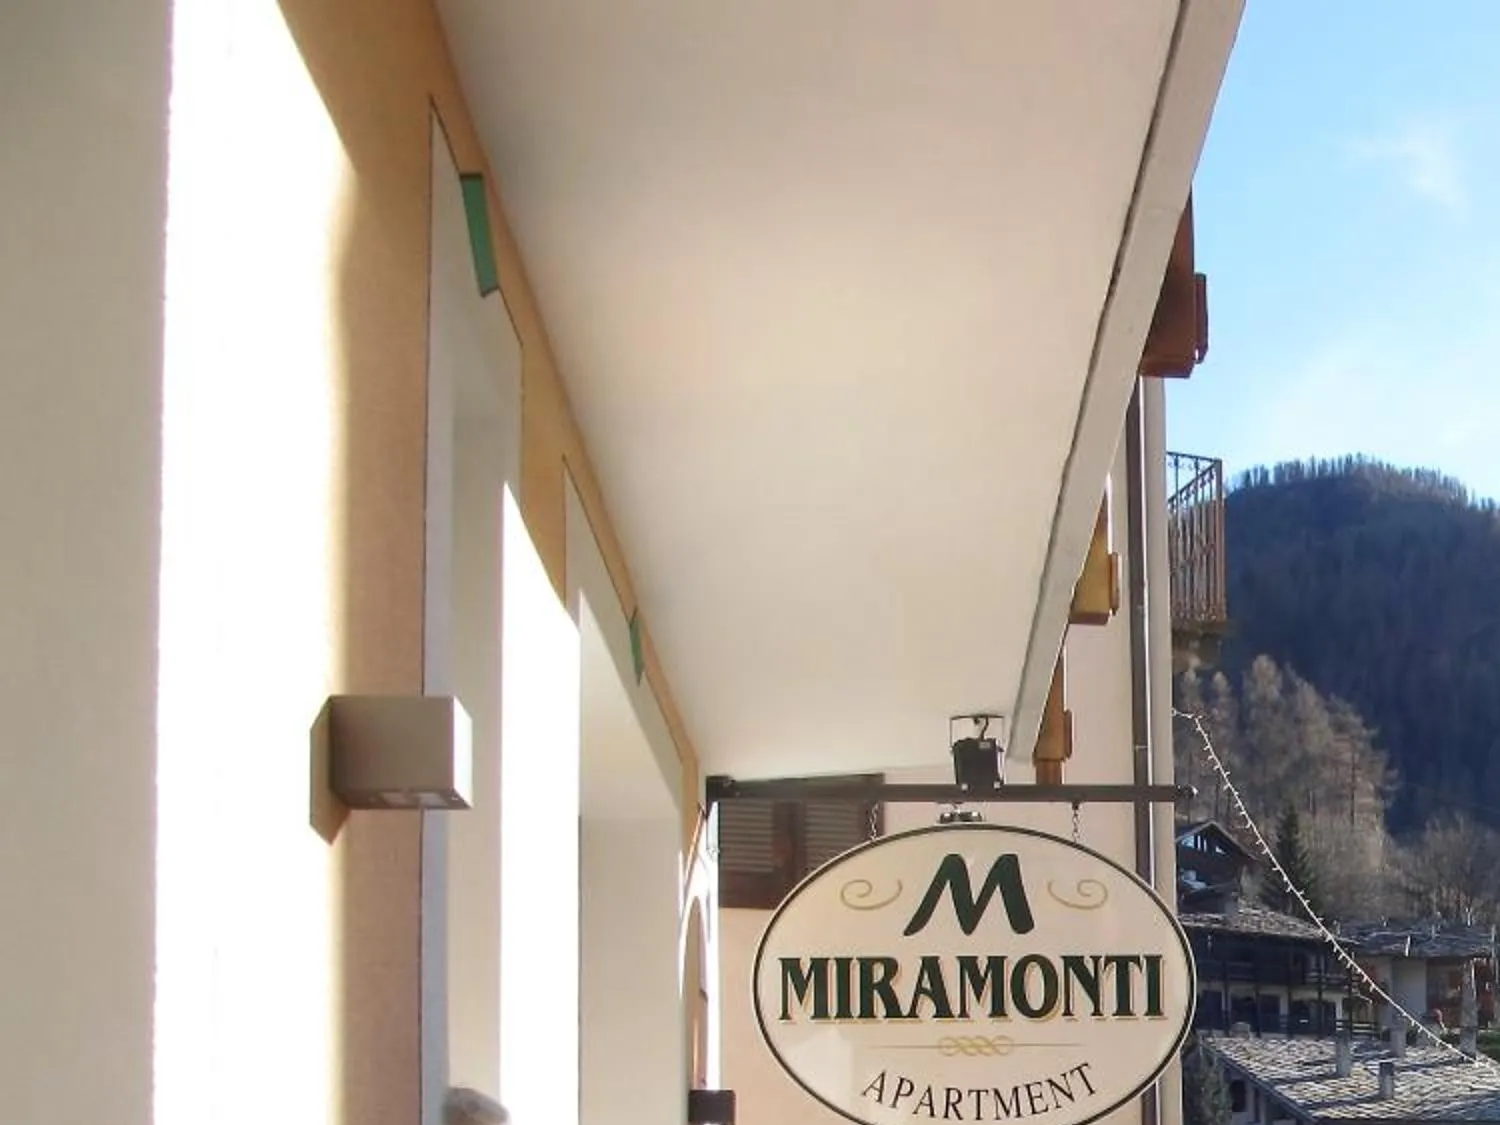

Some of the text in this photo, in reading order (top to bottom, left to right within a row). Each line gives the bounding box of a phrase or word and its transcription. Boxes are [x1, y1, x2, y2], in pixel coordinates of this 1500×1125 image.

[903, 853, 1035, 937] M
[778, 953, 1167, 1023] MIRAMONTI
[862, 1062, 1098, 1122] APARTMENT
